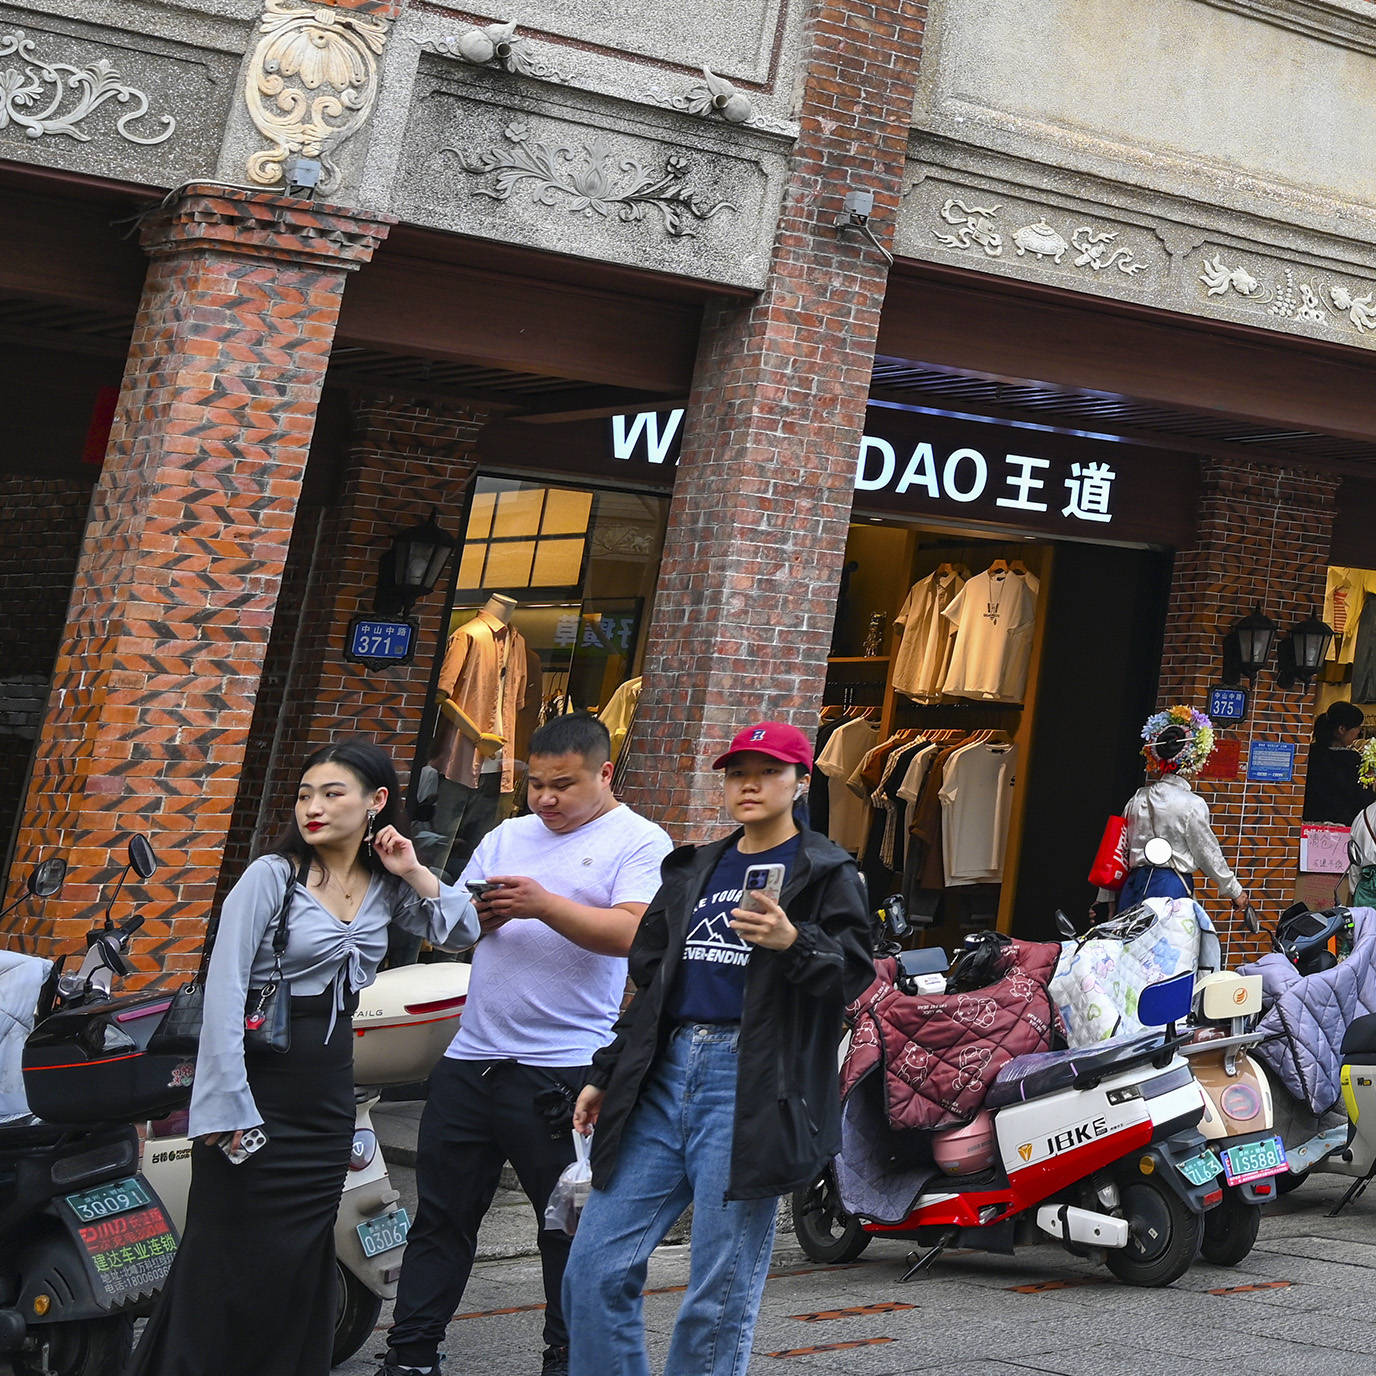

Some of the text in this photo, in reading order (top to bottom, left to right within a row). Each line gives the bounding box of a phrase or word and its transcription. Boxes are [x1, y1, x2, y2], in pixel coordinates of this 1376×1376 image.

[996, 454, 1117, 523] 王道
[361, 624, 407, 636] 中山中路
[358, 635, 391, 655] 371
[1214, 692, 1242, 701] 中山中路
[1213, 700, 1234, 715] 375
[92, 1233, 178, 1272] 建达车业连锁
